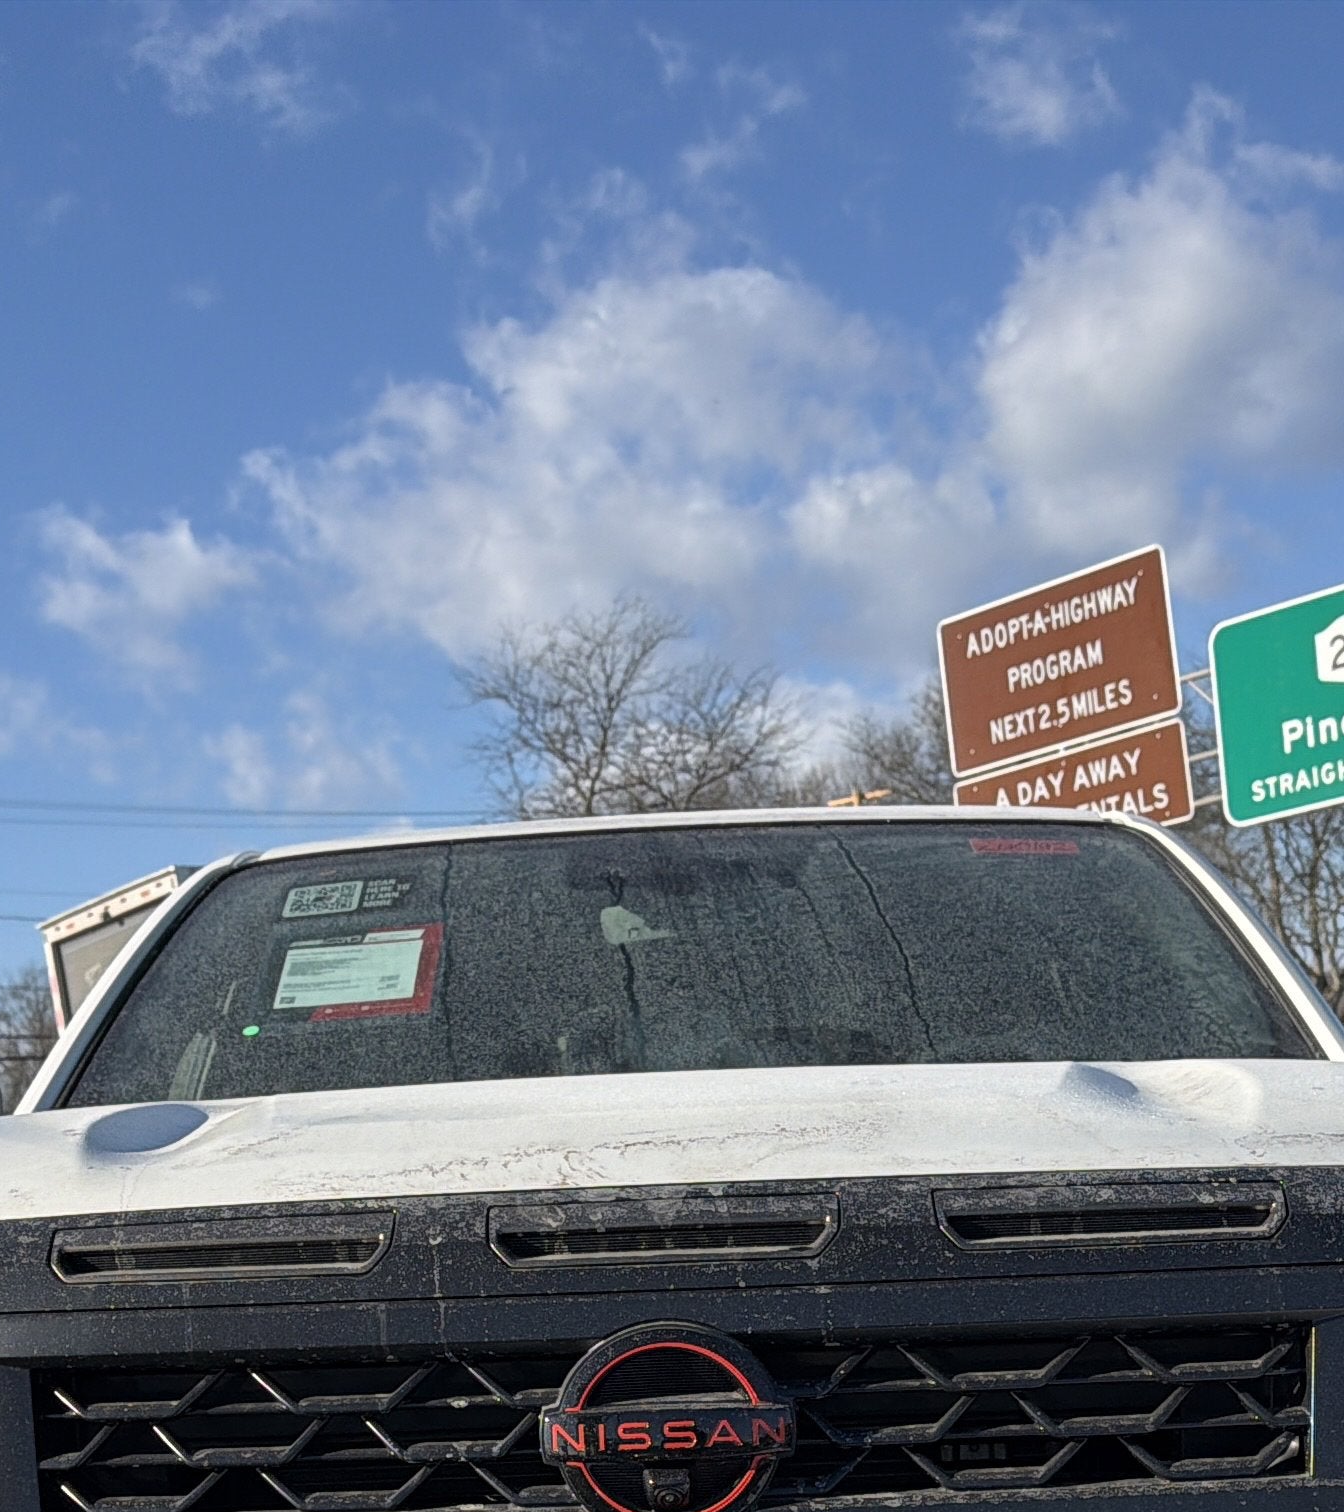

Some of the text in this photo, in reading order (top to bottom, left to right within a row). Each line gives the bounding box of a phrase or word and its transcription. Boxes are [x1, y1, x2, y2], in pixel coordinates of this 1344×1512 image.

[966, 576, 1138, 659] ADOPT-A-HIGHWAY
[1007, 638, 1104, 693] PROGRAM
[989, 678, 1133, 745] NEXT 2.5 MILES
[996, 747, 1141, 807] A DAY AWAY
[551, 1417, 787, 1453] NISSAN
